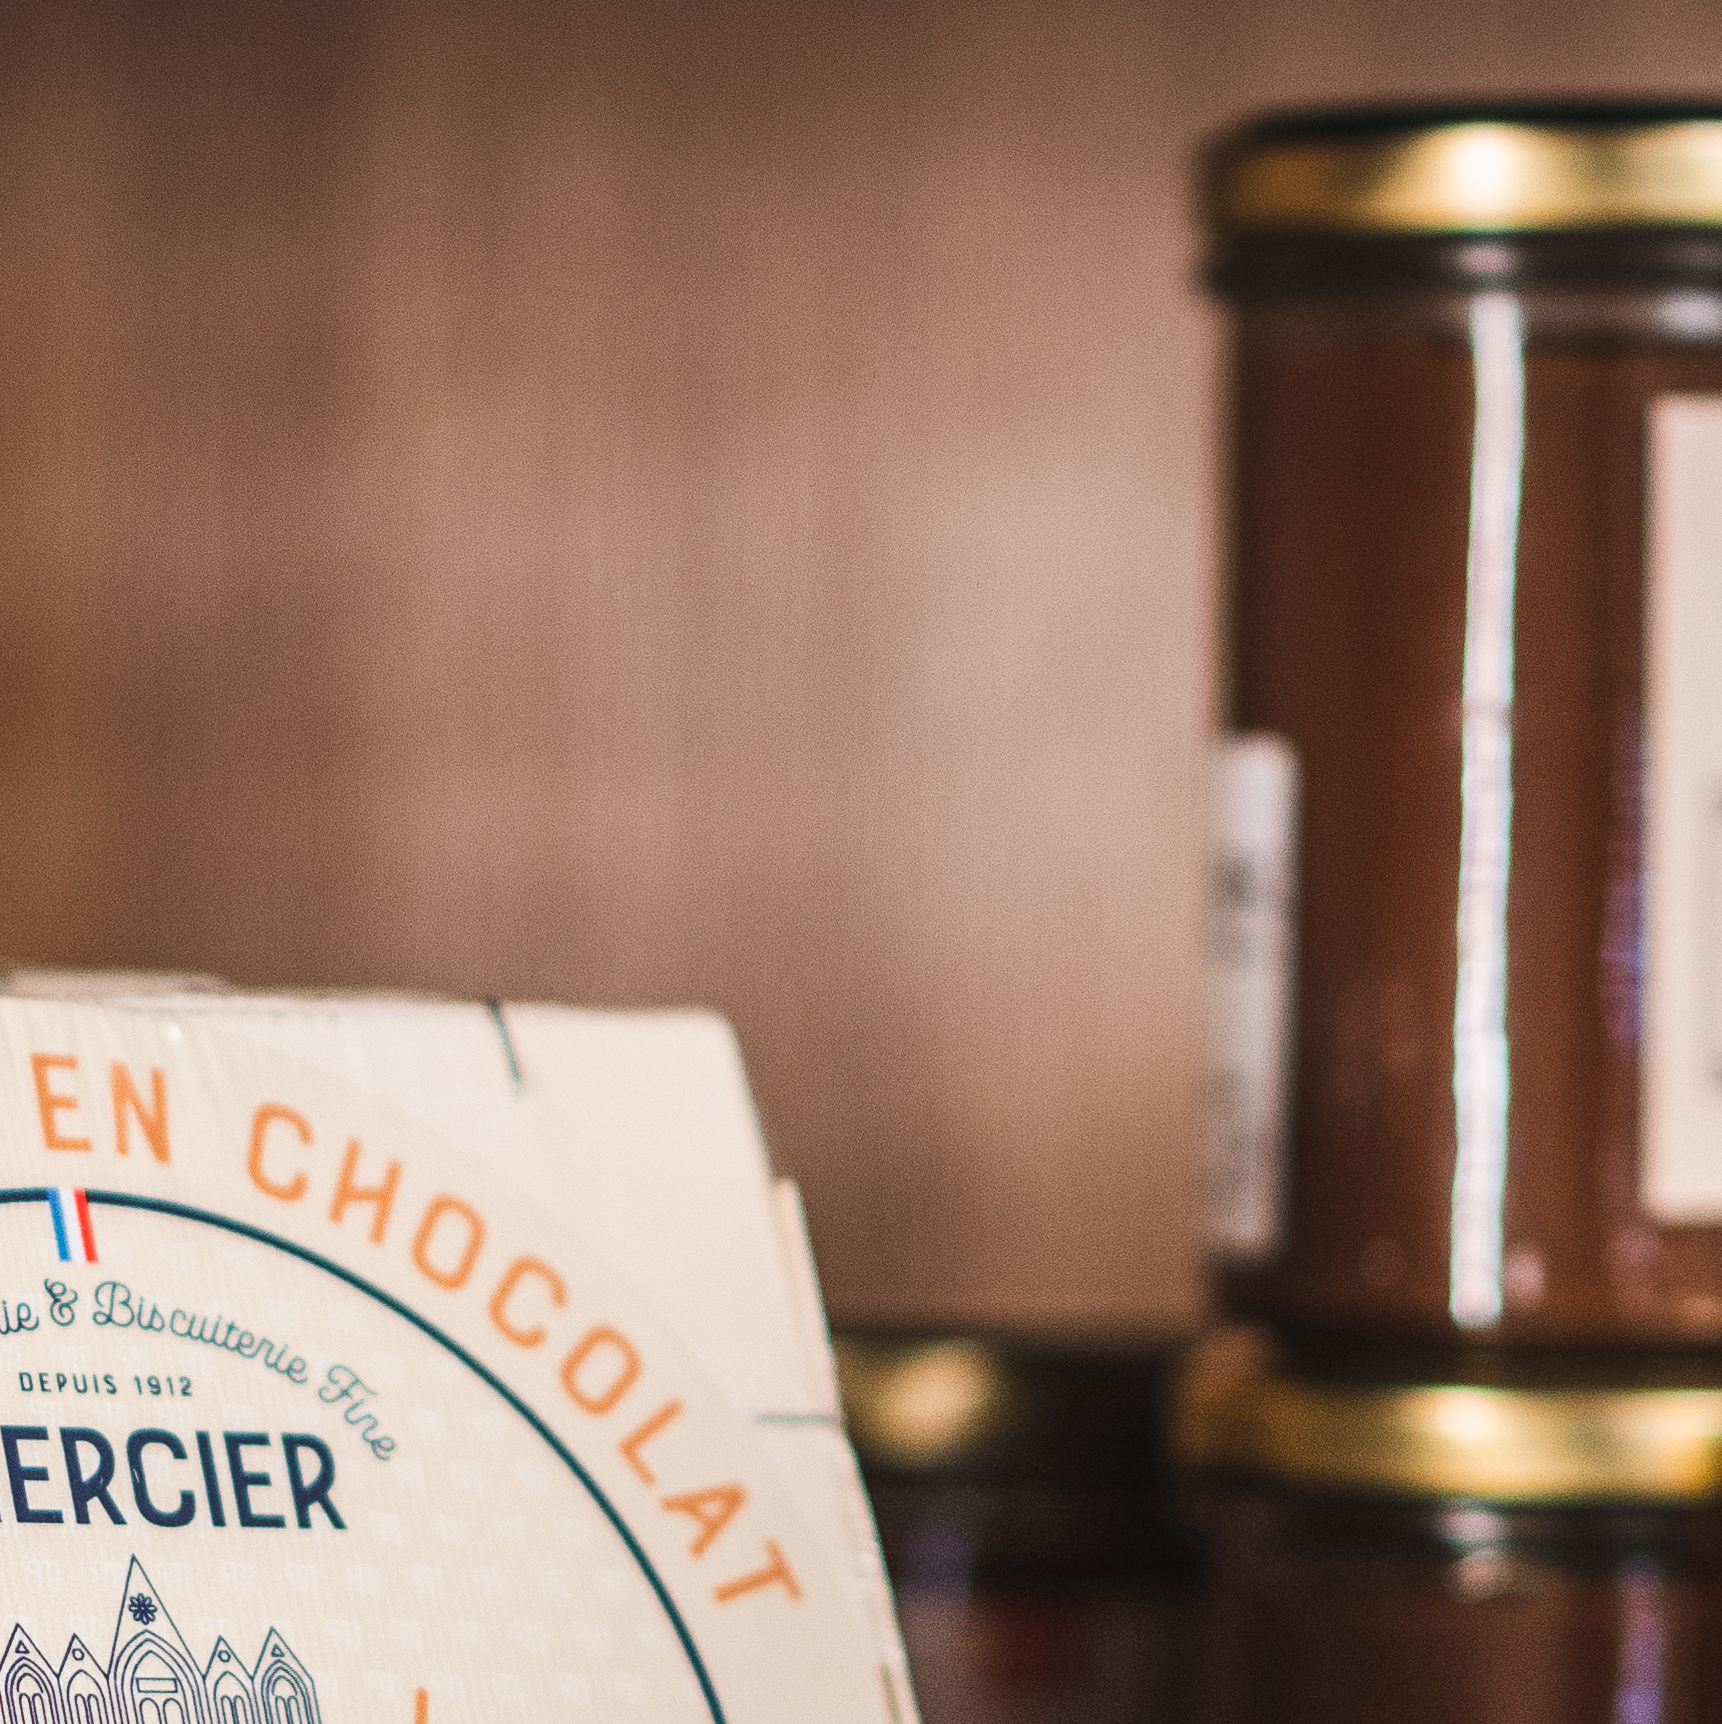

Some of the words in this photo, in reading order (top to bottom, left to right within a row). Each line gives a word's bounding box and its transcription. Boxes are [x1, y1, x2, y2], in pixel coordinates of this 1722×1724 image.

[18, 1371, 118, 1395] DEPUIS
[133, 1375, 193, 1398] 1912
[29, 1051, 172, 1165] EN
[245, 1102, 804, 1607] CHOCOLAT
[43, 1278, 78, 1327] &
[92, 1280, 309, 1386] Biscuiterie
[317, 1363, 399, 1462] Fine
